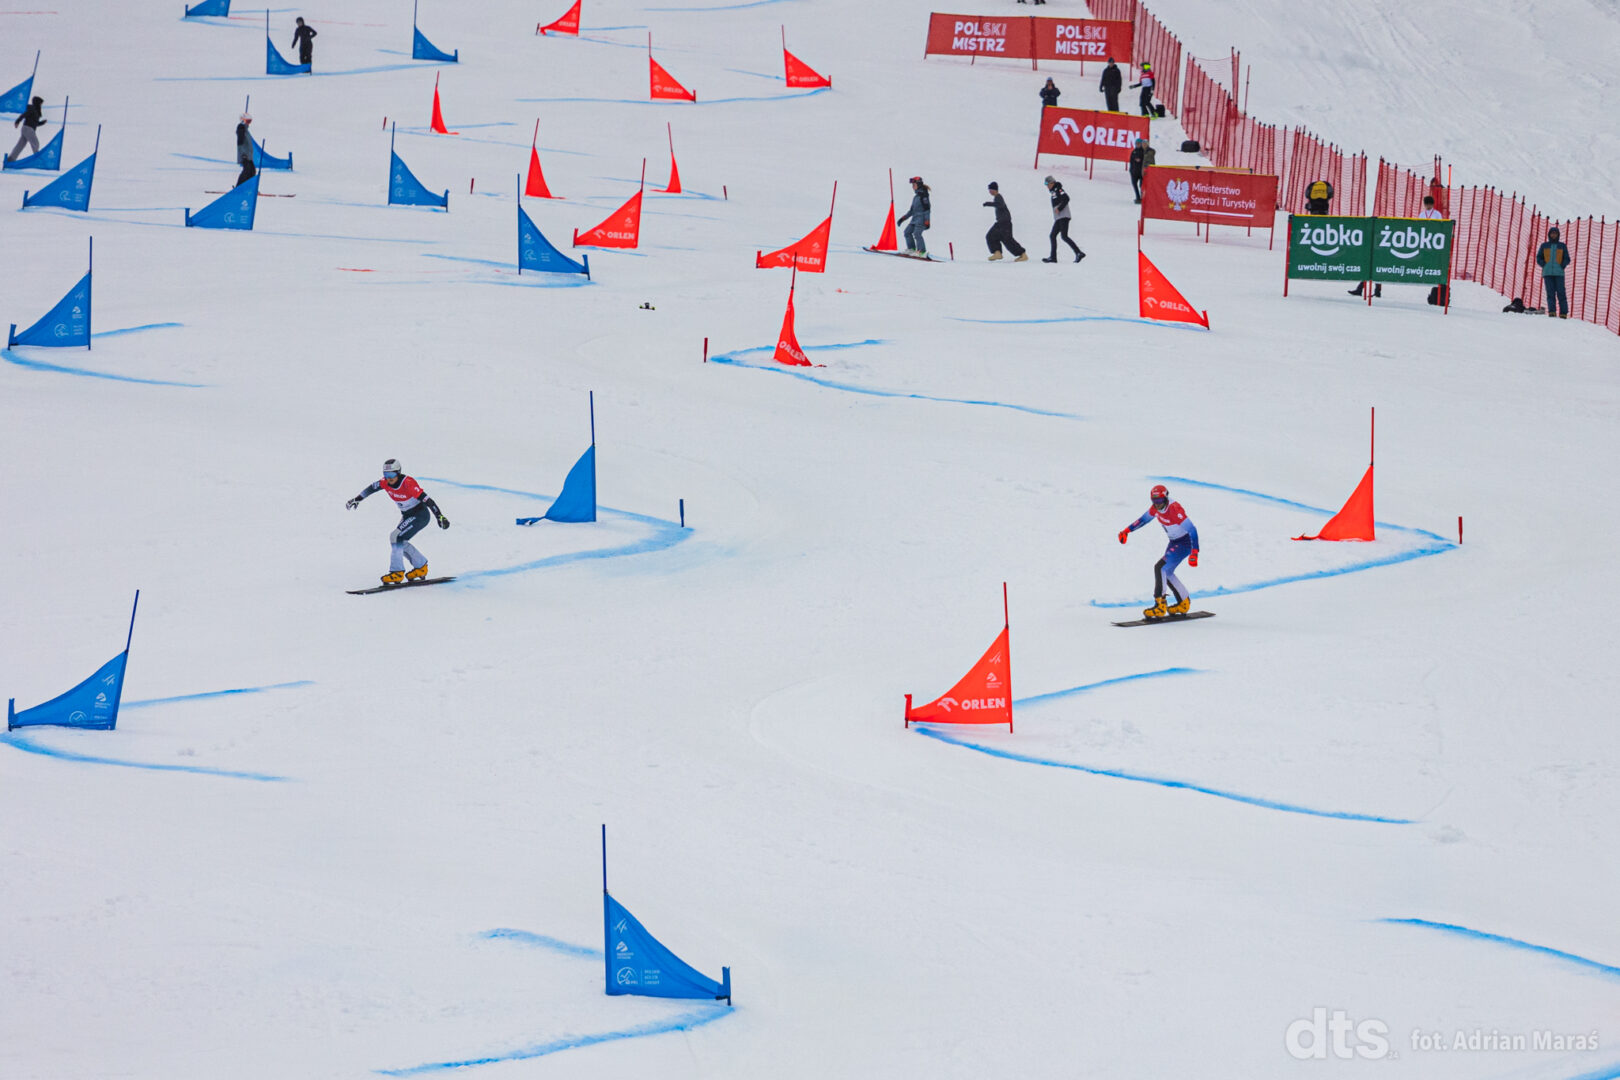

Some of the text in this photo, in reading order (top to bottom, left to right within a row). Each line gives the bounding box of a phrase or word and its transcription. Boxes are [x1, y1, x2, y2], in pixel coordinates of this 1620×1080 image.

[954, 21, 1007, 36] POLSKI
[1055, 25, 1107, 40] POLSKI
[952, 37, 1006, 52] MISTRZ
[1055, 41, 1106, 56] MISTRZ
[1082, 125, 1140, 149] ORLEN
[1191, 183, 1241, 196] Ministerstwo
[1191, 195, 1256, 210] Sportu i Turystyki
[607, 231, 635, 240] ORLEN
[1299, 222, 1363, 247] żabka
[1379, 225, 1446, 250] żabka
[1298, 262, 1361, 274] uwolnij swój czas
[1376, 265, 1442, 278] uwolnij swój czas
[1160, 300, 1190, 312] ORLEN
[961, 697, 1005, 711] ORLEN
